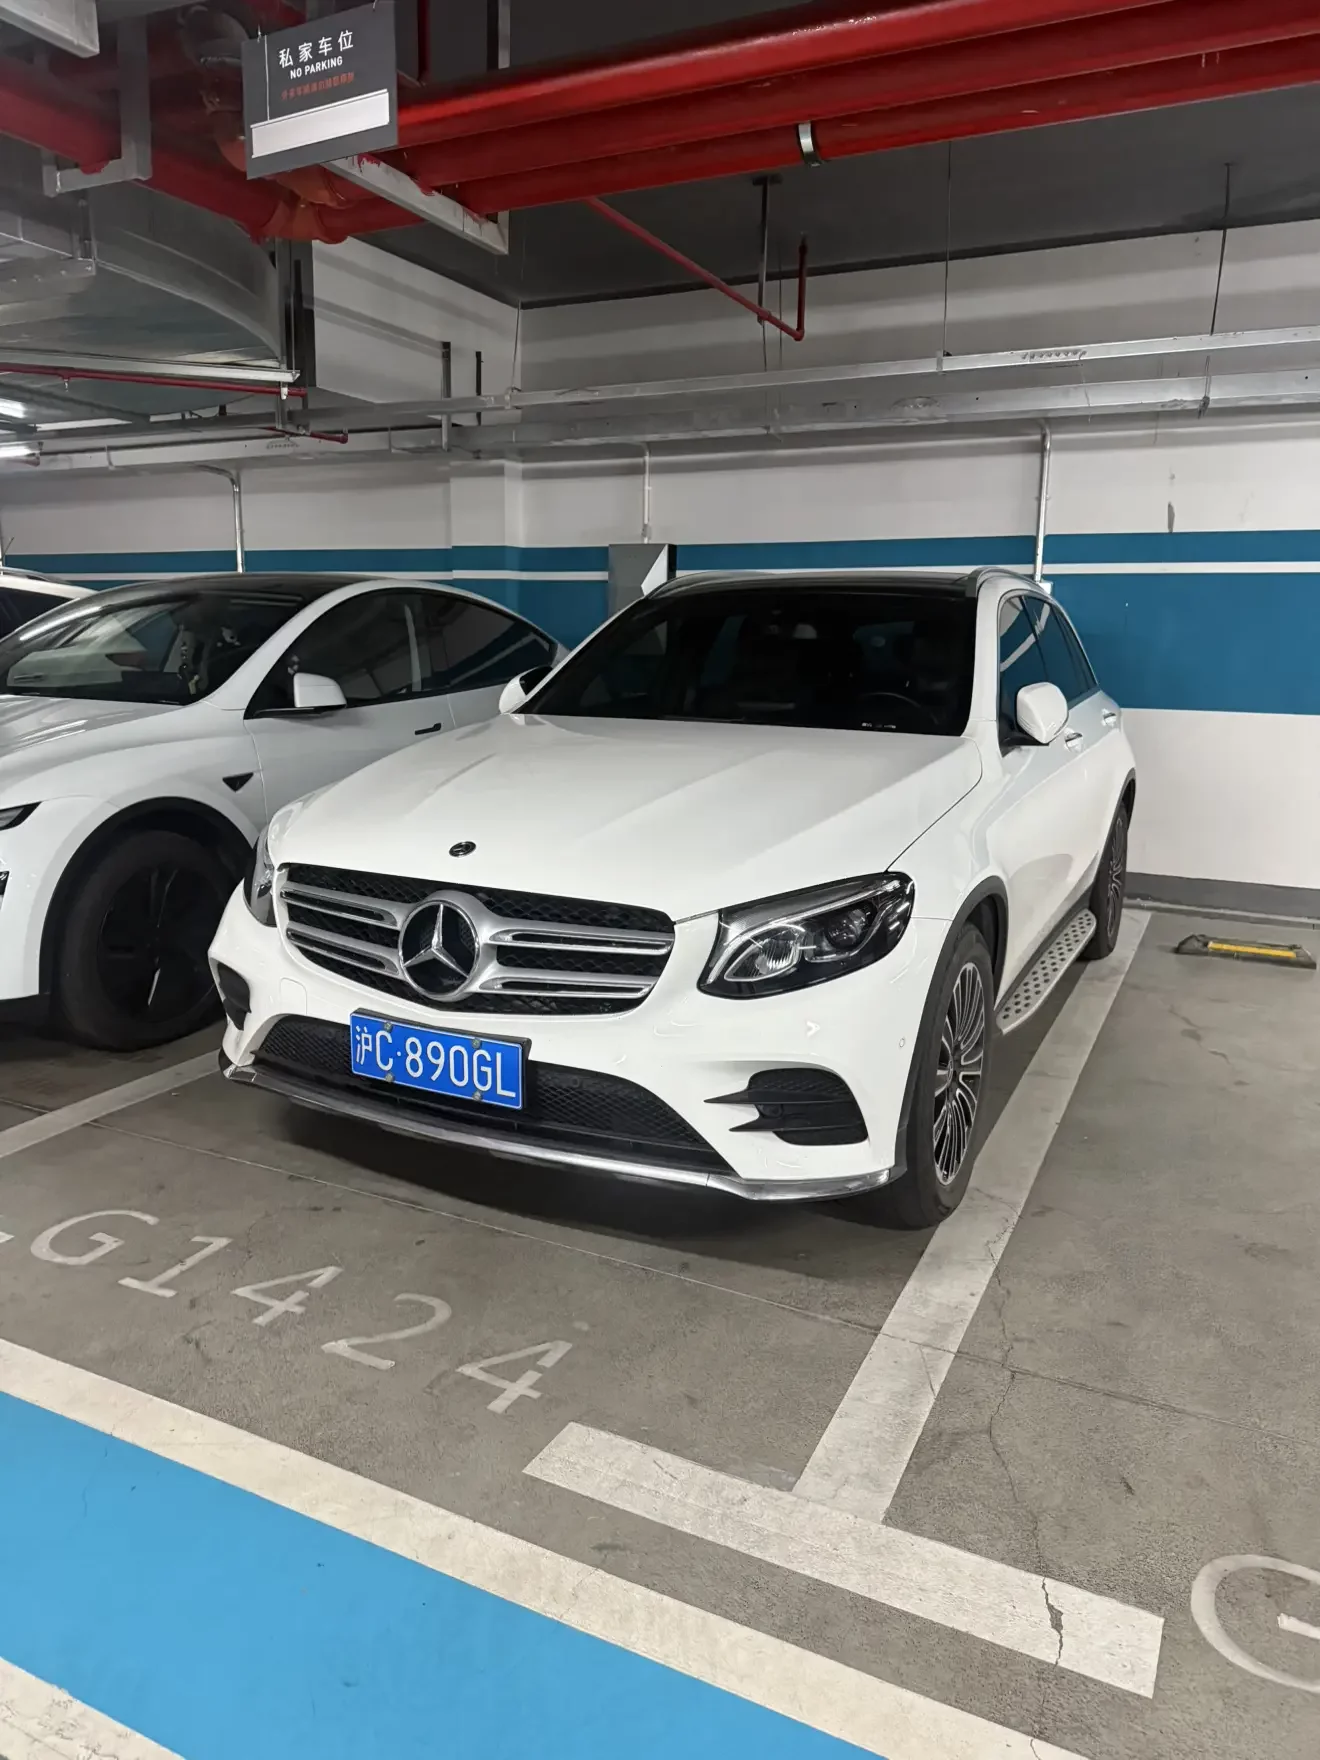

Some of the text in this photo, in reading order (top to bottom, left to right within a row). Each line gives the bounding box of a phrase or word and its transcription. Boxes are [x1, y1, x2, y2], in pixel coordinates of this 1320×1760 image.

[278, 29, 354, 69] 私家车位
[290, 56, 343, 80] NO PARKING
